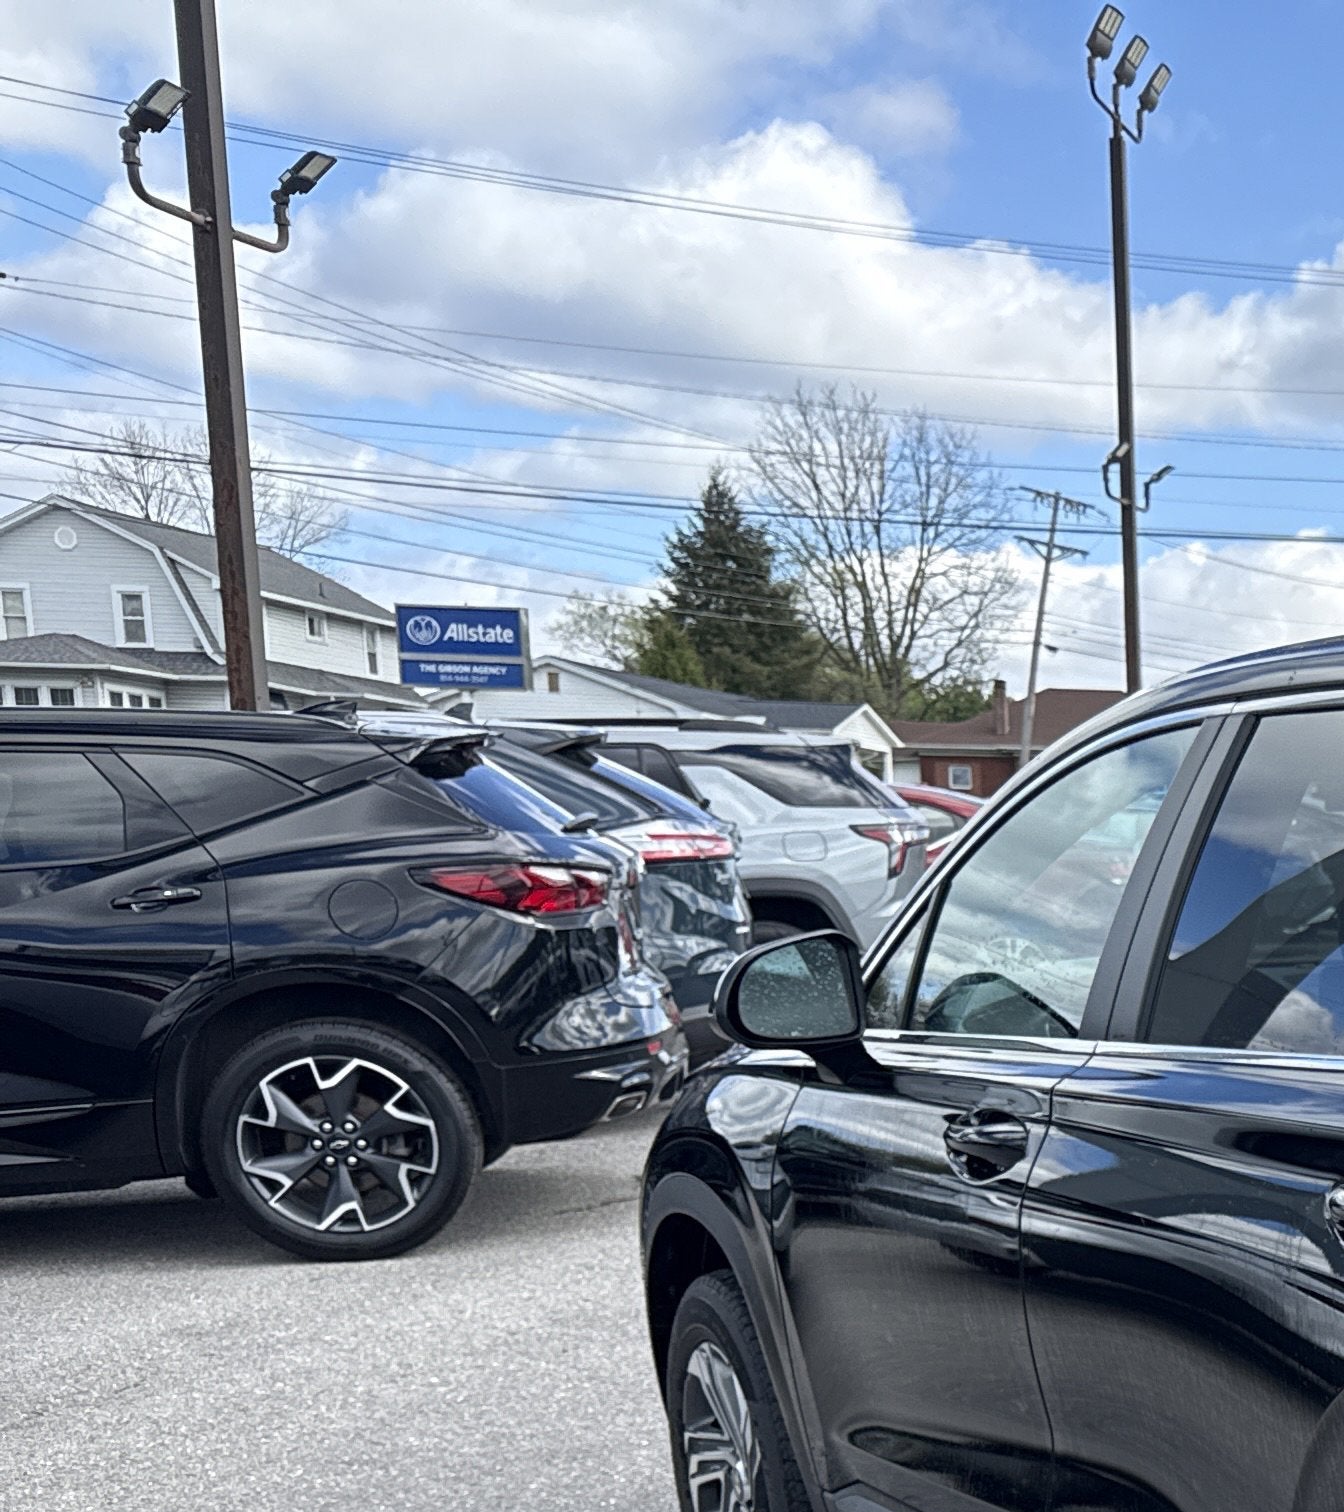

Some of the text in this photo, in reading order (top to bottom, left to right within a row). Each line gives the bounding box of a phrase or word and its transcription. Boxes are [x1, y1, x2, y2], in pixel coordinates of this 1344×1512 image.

[443, 623, 515, 644] Allstate
[419, 663, 437, 673] THE
[471, 665, 508, 676] AGENCY
